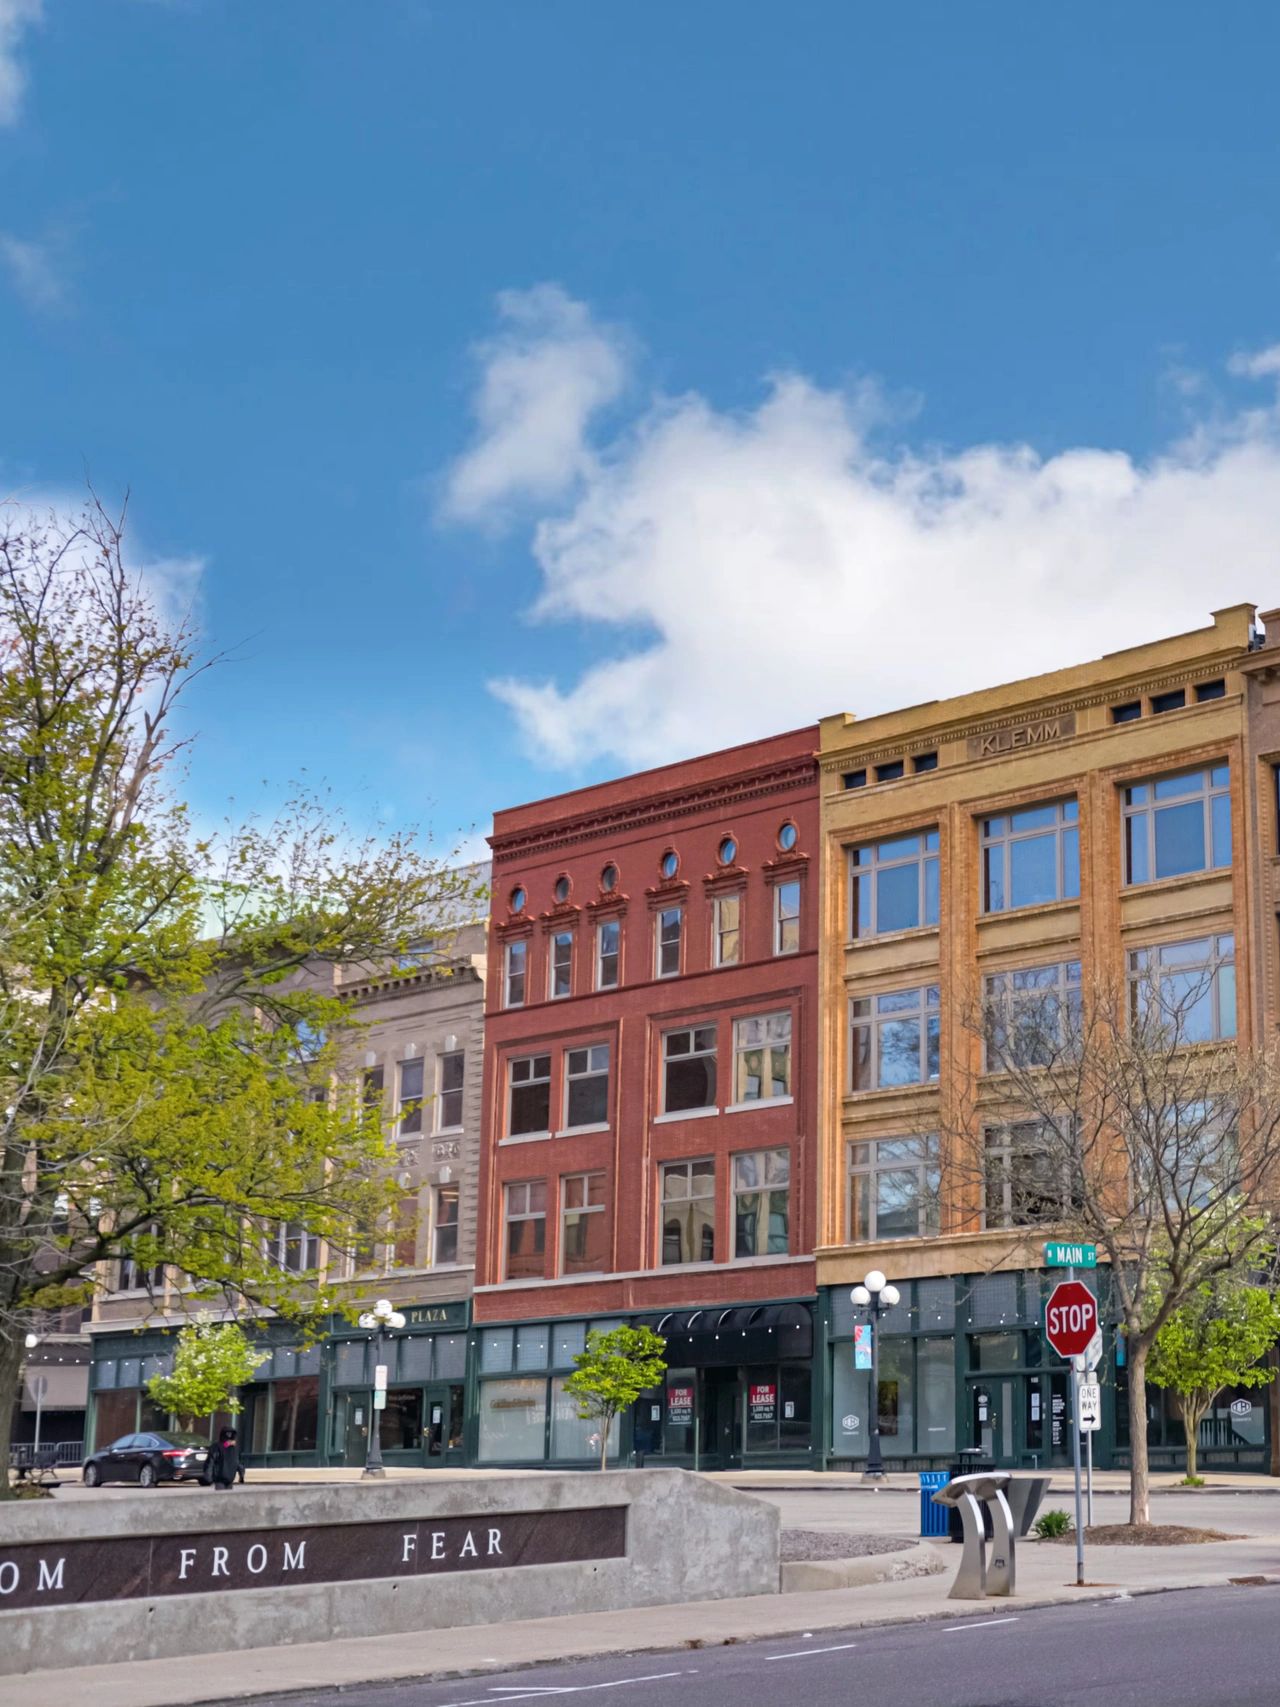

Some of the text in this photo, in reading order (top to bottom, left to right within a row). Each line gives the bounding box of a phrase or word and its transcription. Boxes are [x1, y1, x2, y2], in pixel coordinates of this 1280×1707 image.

[980, 721, 1061, 756] KLEMM
[1057, 1246, 1083, 1264] MAIN
[1088, 1252, 1095, 1261] ST
[411, 1309, 447, 1323] PLAZA
[1050, 1303, 1094, 1335] STOP
[675, 1388, 687, 1396] FOR
[1082, 1387, 1097, 1398] ONE
[670, 1397, 692, 1406] LEASE
[752, 1394, 774, 1403] LEASE
[1081, 1400, 1097, 1411] WAY
[178, 1541, 306, 1580] FROM
[401, 1528, 504, 1562] FEAR
